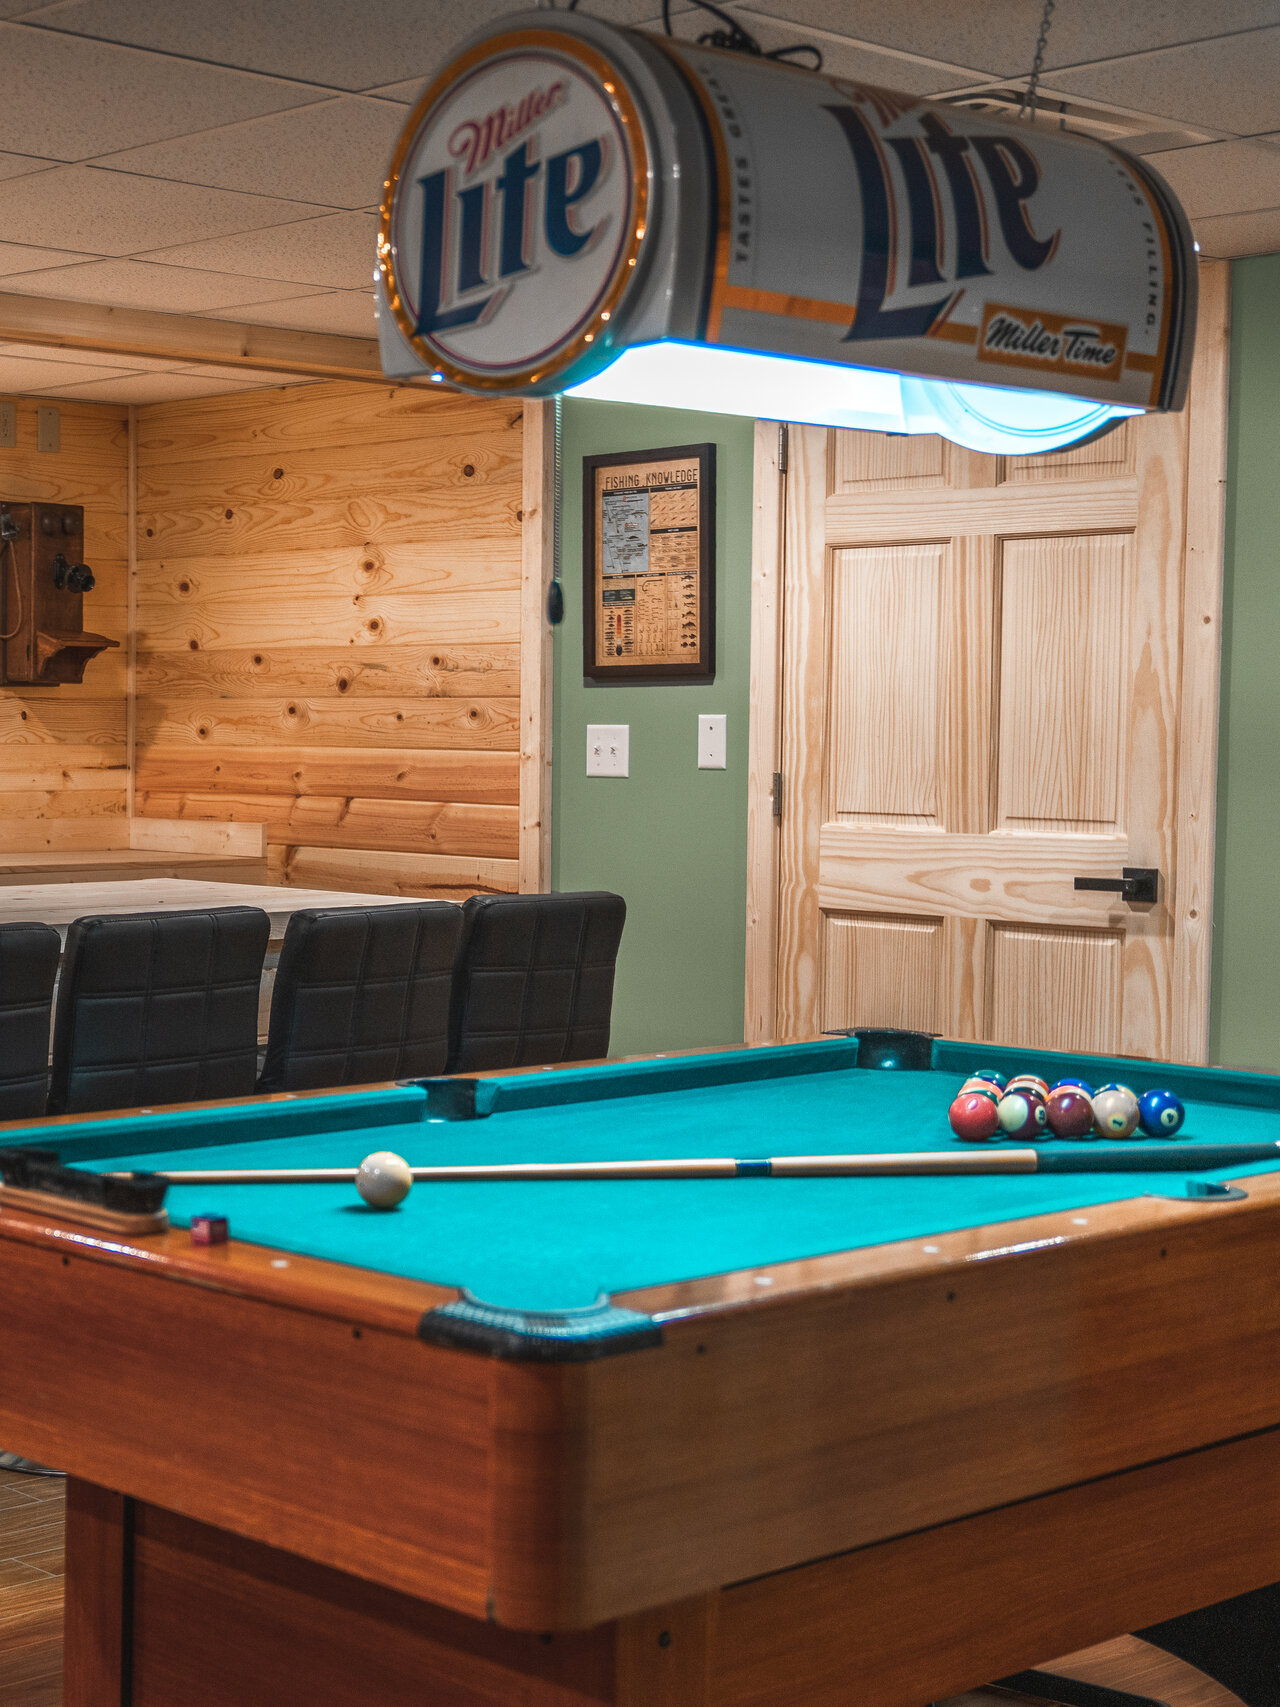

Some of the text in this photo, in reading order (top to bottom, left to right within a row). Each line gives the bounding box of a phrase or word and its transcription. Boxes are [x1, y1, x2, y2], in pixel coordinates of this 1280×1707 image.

[446, 79, 566, 175] Miller
[411, 132, 612, 337] Lite
[734, 156, 751, 262] TASTES
[821, 104, 1061, 343] Lite
[985, 317, 1117, 365] Miller Time
[605, 468, 698, 490] FISHING KNOWLEDGE
